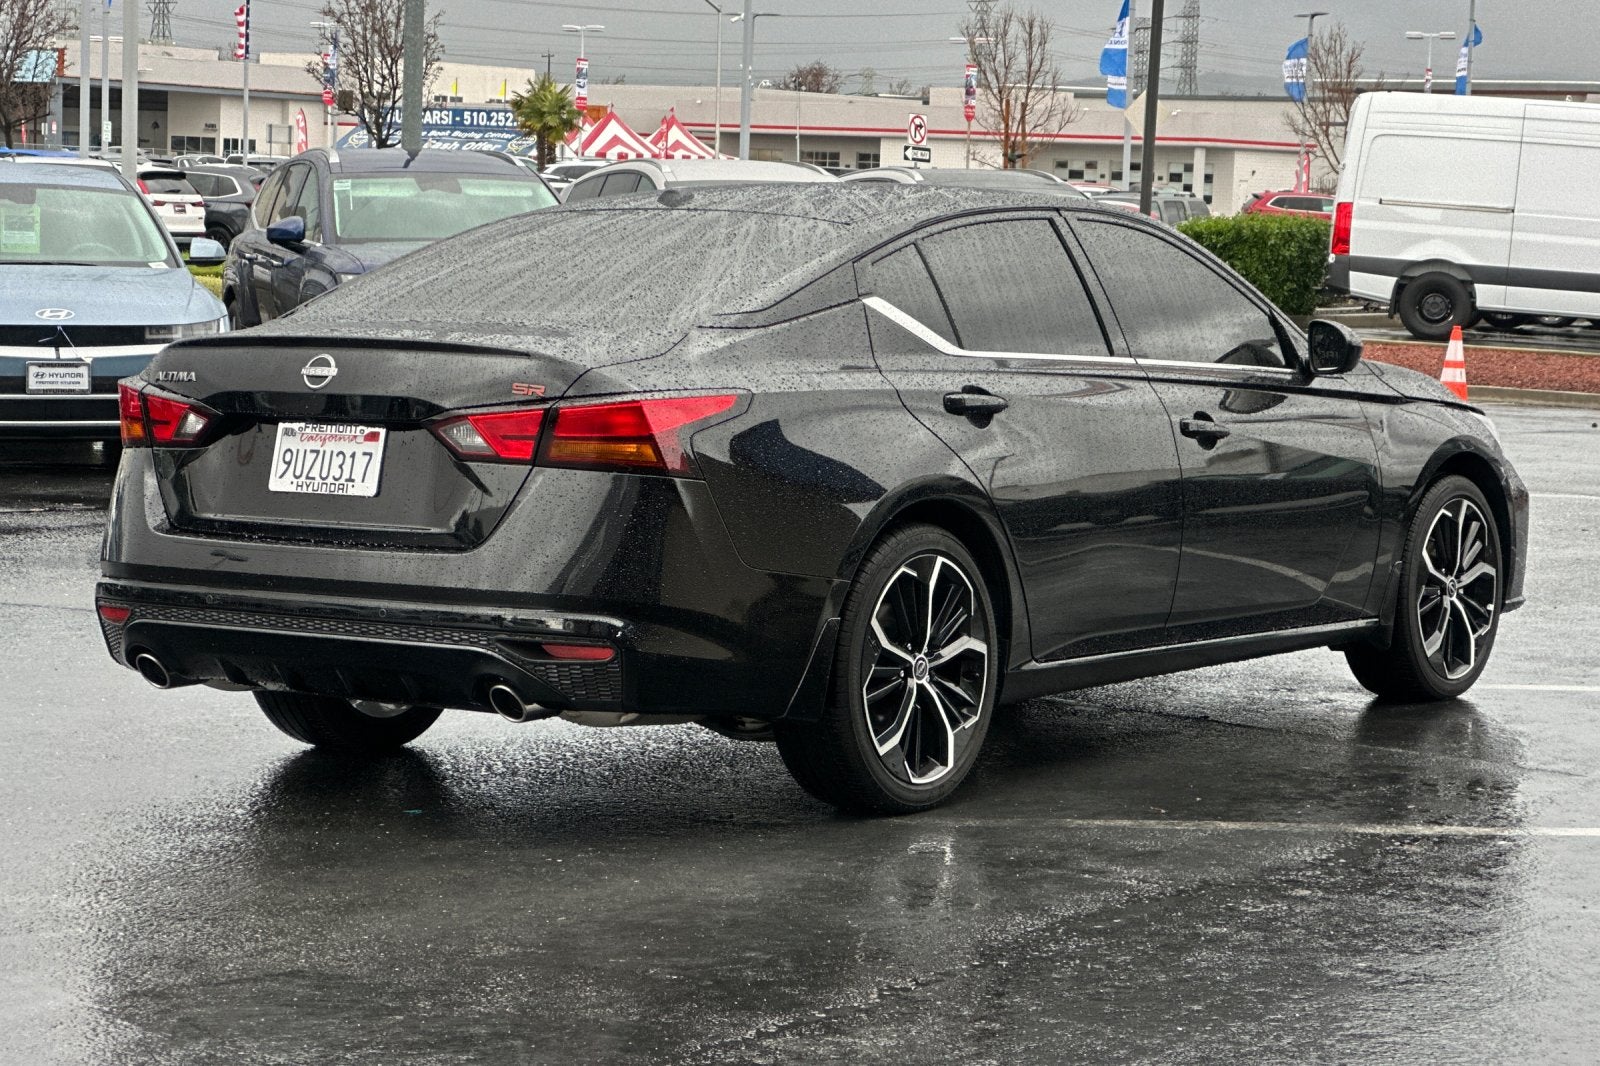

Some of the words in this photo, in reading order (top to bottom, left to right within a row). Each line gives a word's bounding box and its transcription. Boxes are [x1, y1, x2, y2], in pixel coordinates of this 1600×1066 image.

[462, 142, 502, 151] Offer
[511, 382, 546, 397] SR
[304, 423, 359, 433] FREMONT
[278, 448, 373, 483] 9UZU317
[295, 481, 349, 493] HYUNDAI
